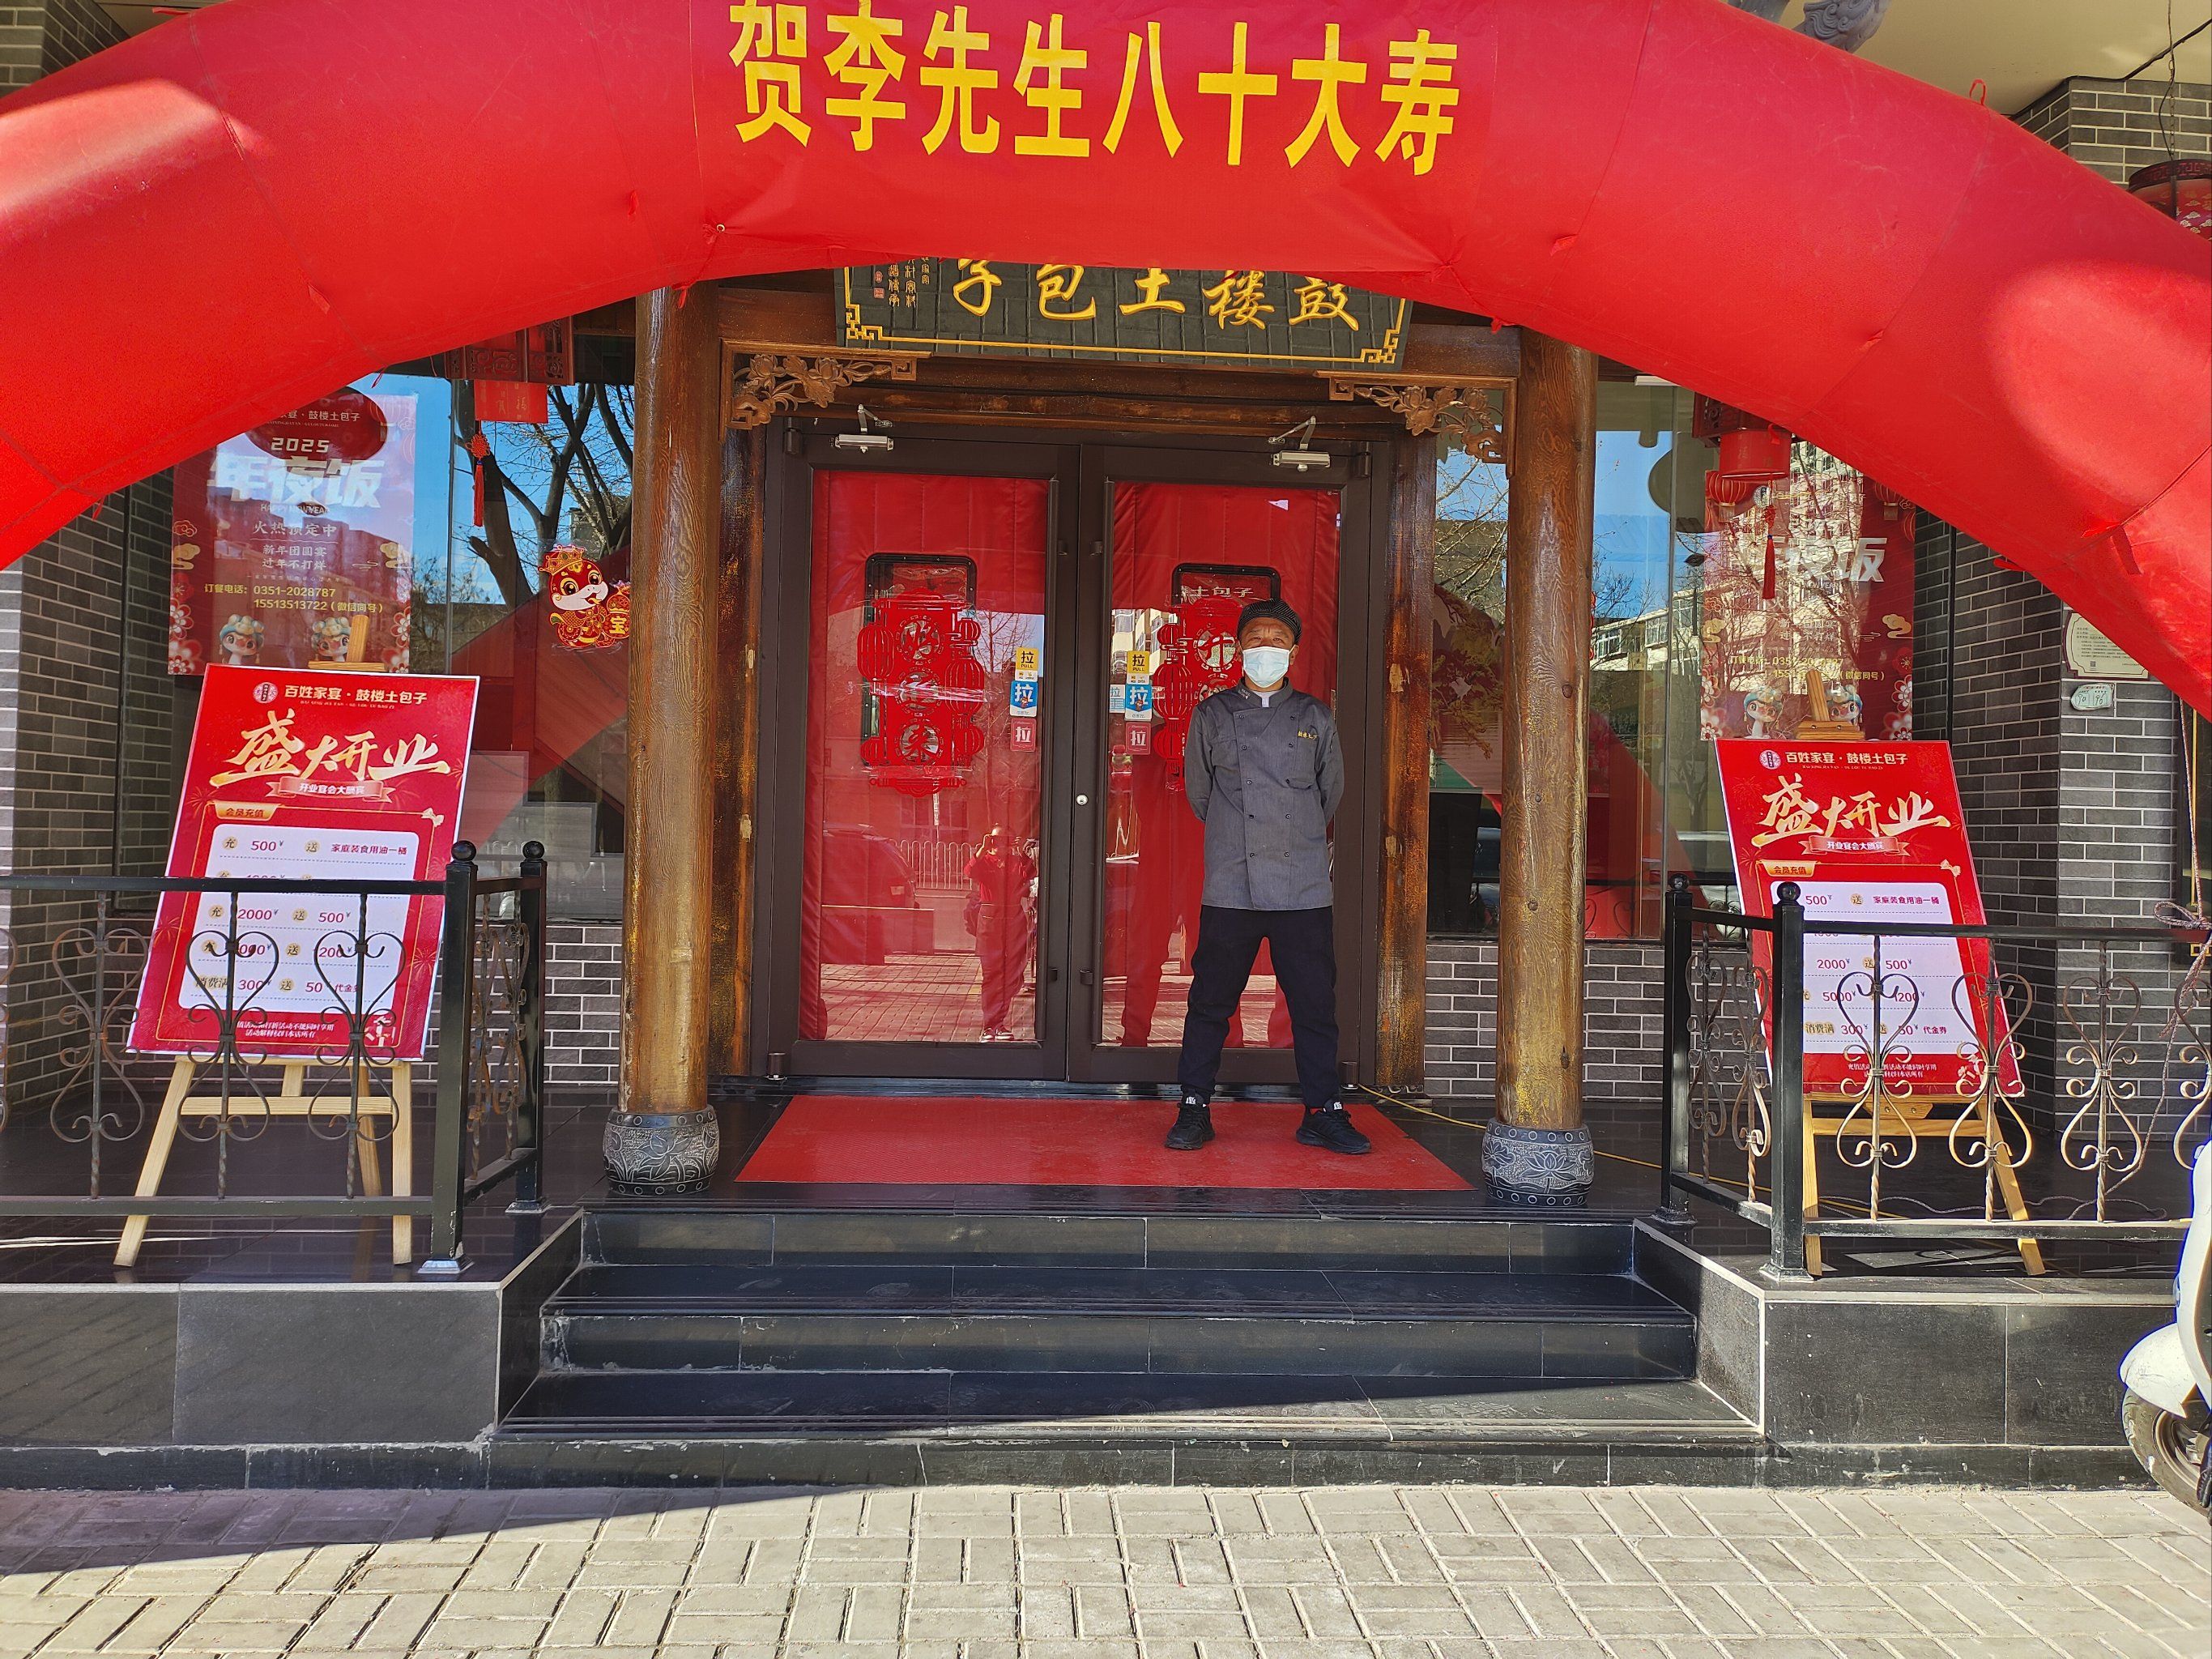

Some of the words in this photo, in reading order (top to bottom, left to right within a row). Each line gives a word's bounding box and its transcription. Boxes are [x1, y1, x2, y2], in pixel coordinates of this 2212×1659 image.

[729, 0, 1460, 176] 贺李先生八十大寿
[271, 437, 330, 454] 2025
[206, 453, 386, 509] 年夜饭
[253, 521, 338, 538] 火热预定中
[262, 544, 327, 557] 新年团圆宴
[262, 557, 327, 571] 过年不打烊
[253, 585, 336, 598] 0351-2028787
[609, 616, 627, 634] 宝
[1021, 650, 1034, 663] 拉
[1132, 654, 1145, 666] 拉
[1014, 683, 1034, 702] 拉
[1129, 686, 1149, 705] 拉
[1015, 726, 1032, 743] 拉
[1130, 730, 1147, 746] 拉
[209, 707, 451, 787] 盛大开业
[226, 807, 265, 818] 会员充值
[1750, 772, 1952, 848] 盛大开业
[224, 838, 236, 849] 充
[305, 842, 318, 853] 送
[331, 843, 408, 855] 家庭装食用油一桶
[1773, 866, 1807, 875] 会员充值
[1852, 895, 1863, 905] 送
[1873, 896, 1940, 905] 家庭装食用油一桶
[211, 906, 222, 917] 充
[293, 910, 305, 921] 送
[287, 945, 299, 956] 送
[279, 980, 292, 991] 送
[1805, 1023, 1835, 1034] 消费满
[1923, 1026, 1947, 1035] 代金券
